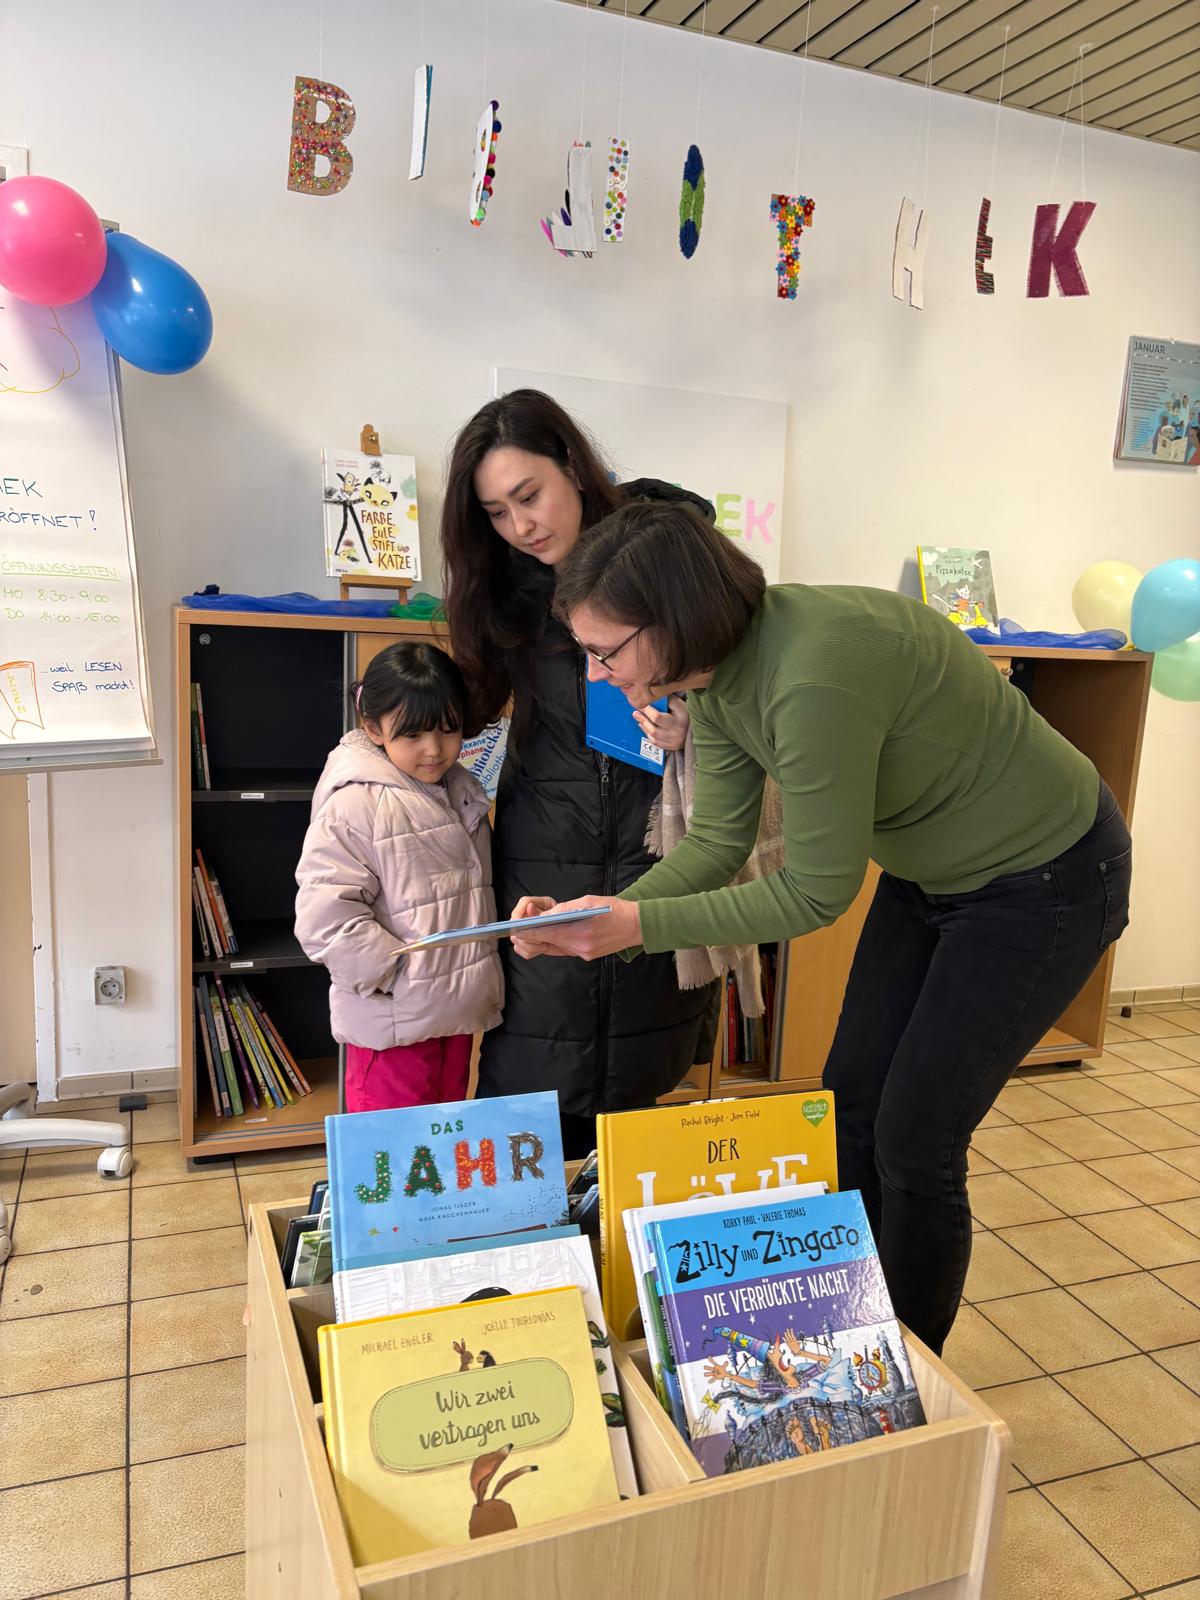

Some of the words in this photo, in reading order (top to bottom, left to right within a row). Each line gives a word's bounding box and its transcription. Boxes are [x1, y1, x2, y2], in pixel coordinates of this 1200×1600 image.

[1133, 342, 1166, 354] JANUAR
[361, 510, 395, 527] FARBE,
[372, 539, 395, 552] STIFT
[378, 551, 412, 570] KATZE
[84, 661, 123, 673] LESEN
[430, 1119, 465, 1136] DAS
[708, 1138, 740, 1164] DER
[354, 1132, 545, 1204] JAHR
[723, 1217, 741, 1229] KORKY
[760, 1211, 784, 1223] VALERIE
[783, 1206, 806, 1219] THOMAS
[667, 1239, 740, 1284] Zilly
[741, 1248, 759, 1262] UND
[752, 1224, 860, 1265] Zingaro
[703, 1292, 730, 1319] DIE
[729, 1277, 807, 1314] VERRÜCKTE
[806, 1269, 852, 1301] NACHT
[361, 1338, 398, 1356] MICHAEL
[435, 1389, 471, 1413] Wir
[475, 1380, 516, 1406] zwei
[418, 1418, 507, 1450] vertragen
[511, 1411, 541, 1429] uns
